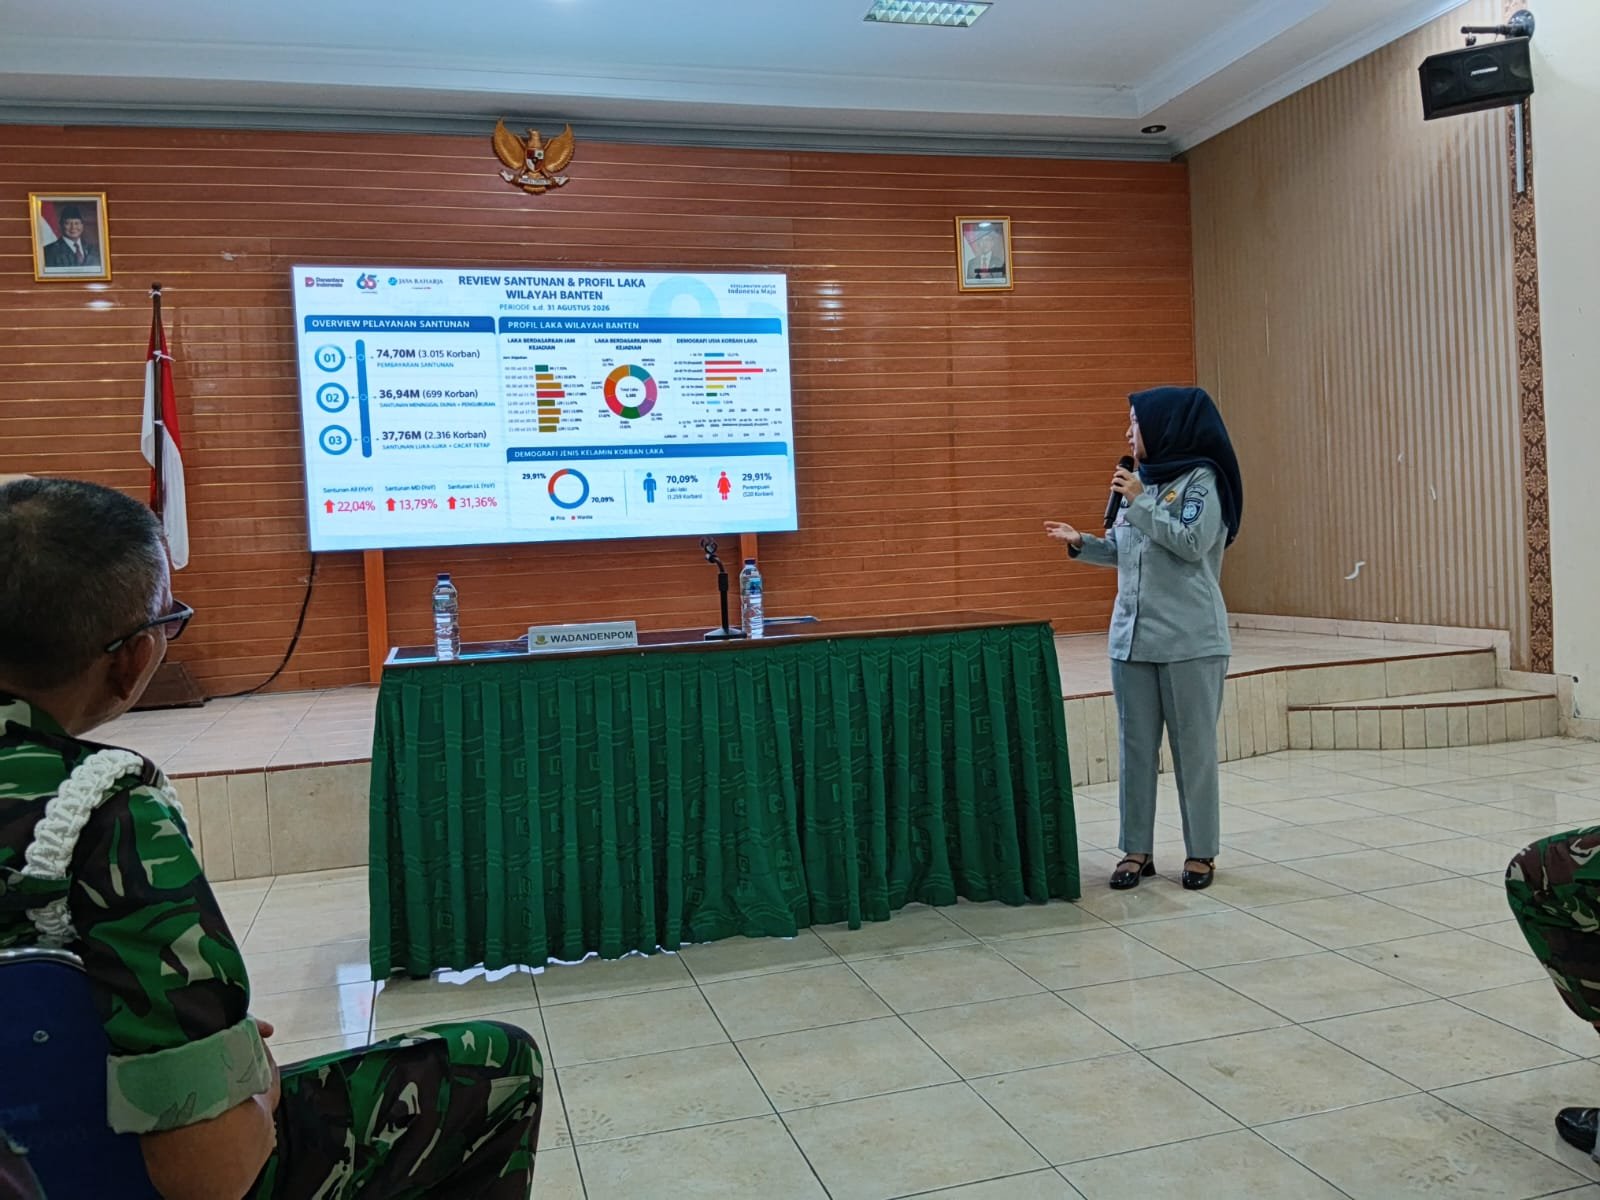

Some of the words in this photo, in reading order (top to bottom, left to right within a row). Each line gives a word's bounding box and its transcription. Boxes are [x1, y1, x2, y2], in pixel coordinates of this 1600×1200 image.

[356, 272, 377, 290] 65
[458, 276, 501, 286] REVIEW
[504, 276, 564, 287] SANTUNAN
[567, 278, 576, 287] &
[578, 278, 614, 288] PROFIL
[617, 278, 646, 288] LAKA
[506, 290, 557, 300] WILAYAH
[560, 290, 603, 300] BANTEN
[312, 319, 360, 328] OVERVIEW
[362, 320, 417, 328] PELAYANAN
[420, 320, 470, 328] SANTUNAN
[324, 353, 336, 363] 01
[376, 349, 416, 359] 74,70M
[418, 349, 444, 359] (3.015
[446, 349, 480, 359] Korban)
[326, 393, 339, 403] 02
[379, 389, 420, 400] 36,94M
[422, 390, 442, 399] (699
[445, 389, 478, 399] Korban)
[328, 436, 342, 445] 03
[382, 431, 421, 442] 37,76M
[424, 431, 450, 441] (2.316
[453, 430, 487, 440] Korban)
[666, 475, 698, 484] 70,09%
[742, 473, 772, 482] 29,91%
[337, 501, 376, 512] 22,04%
[400, 499, 438, 511] 13,79%
[460, 497, 497, 508] 31,36%
[550, 630, 634, 643] WADANDENPOM
